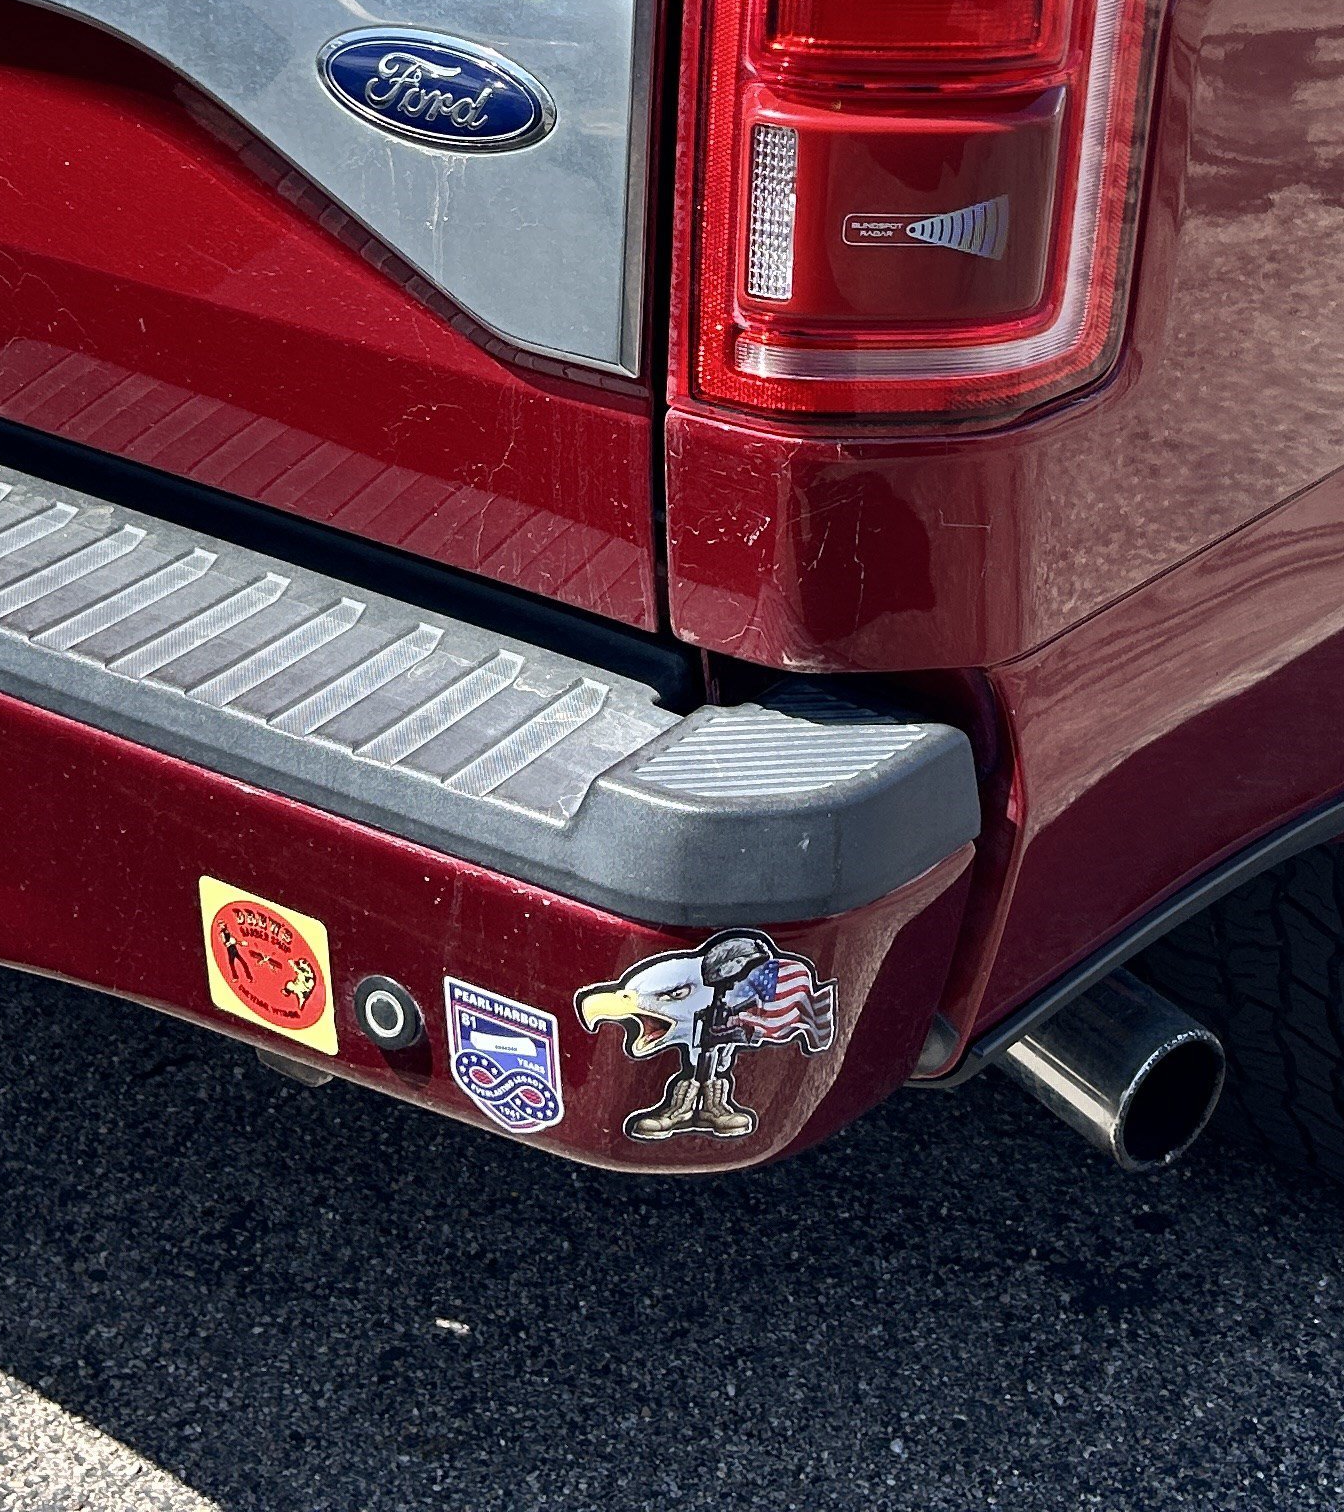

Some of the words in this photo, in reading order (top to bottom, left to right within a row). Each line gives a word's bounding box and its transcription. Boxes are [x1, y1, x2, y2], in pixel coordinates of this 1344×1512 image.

[364, 52, 493, 130] Ford
[454, 987, 493, 1012] PEARL
[494, 1001, 548, 1032] HARBOR
[460, 1012, 477, 1030] 81
[517, 1057, 546, 1074] YEARS
